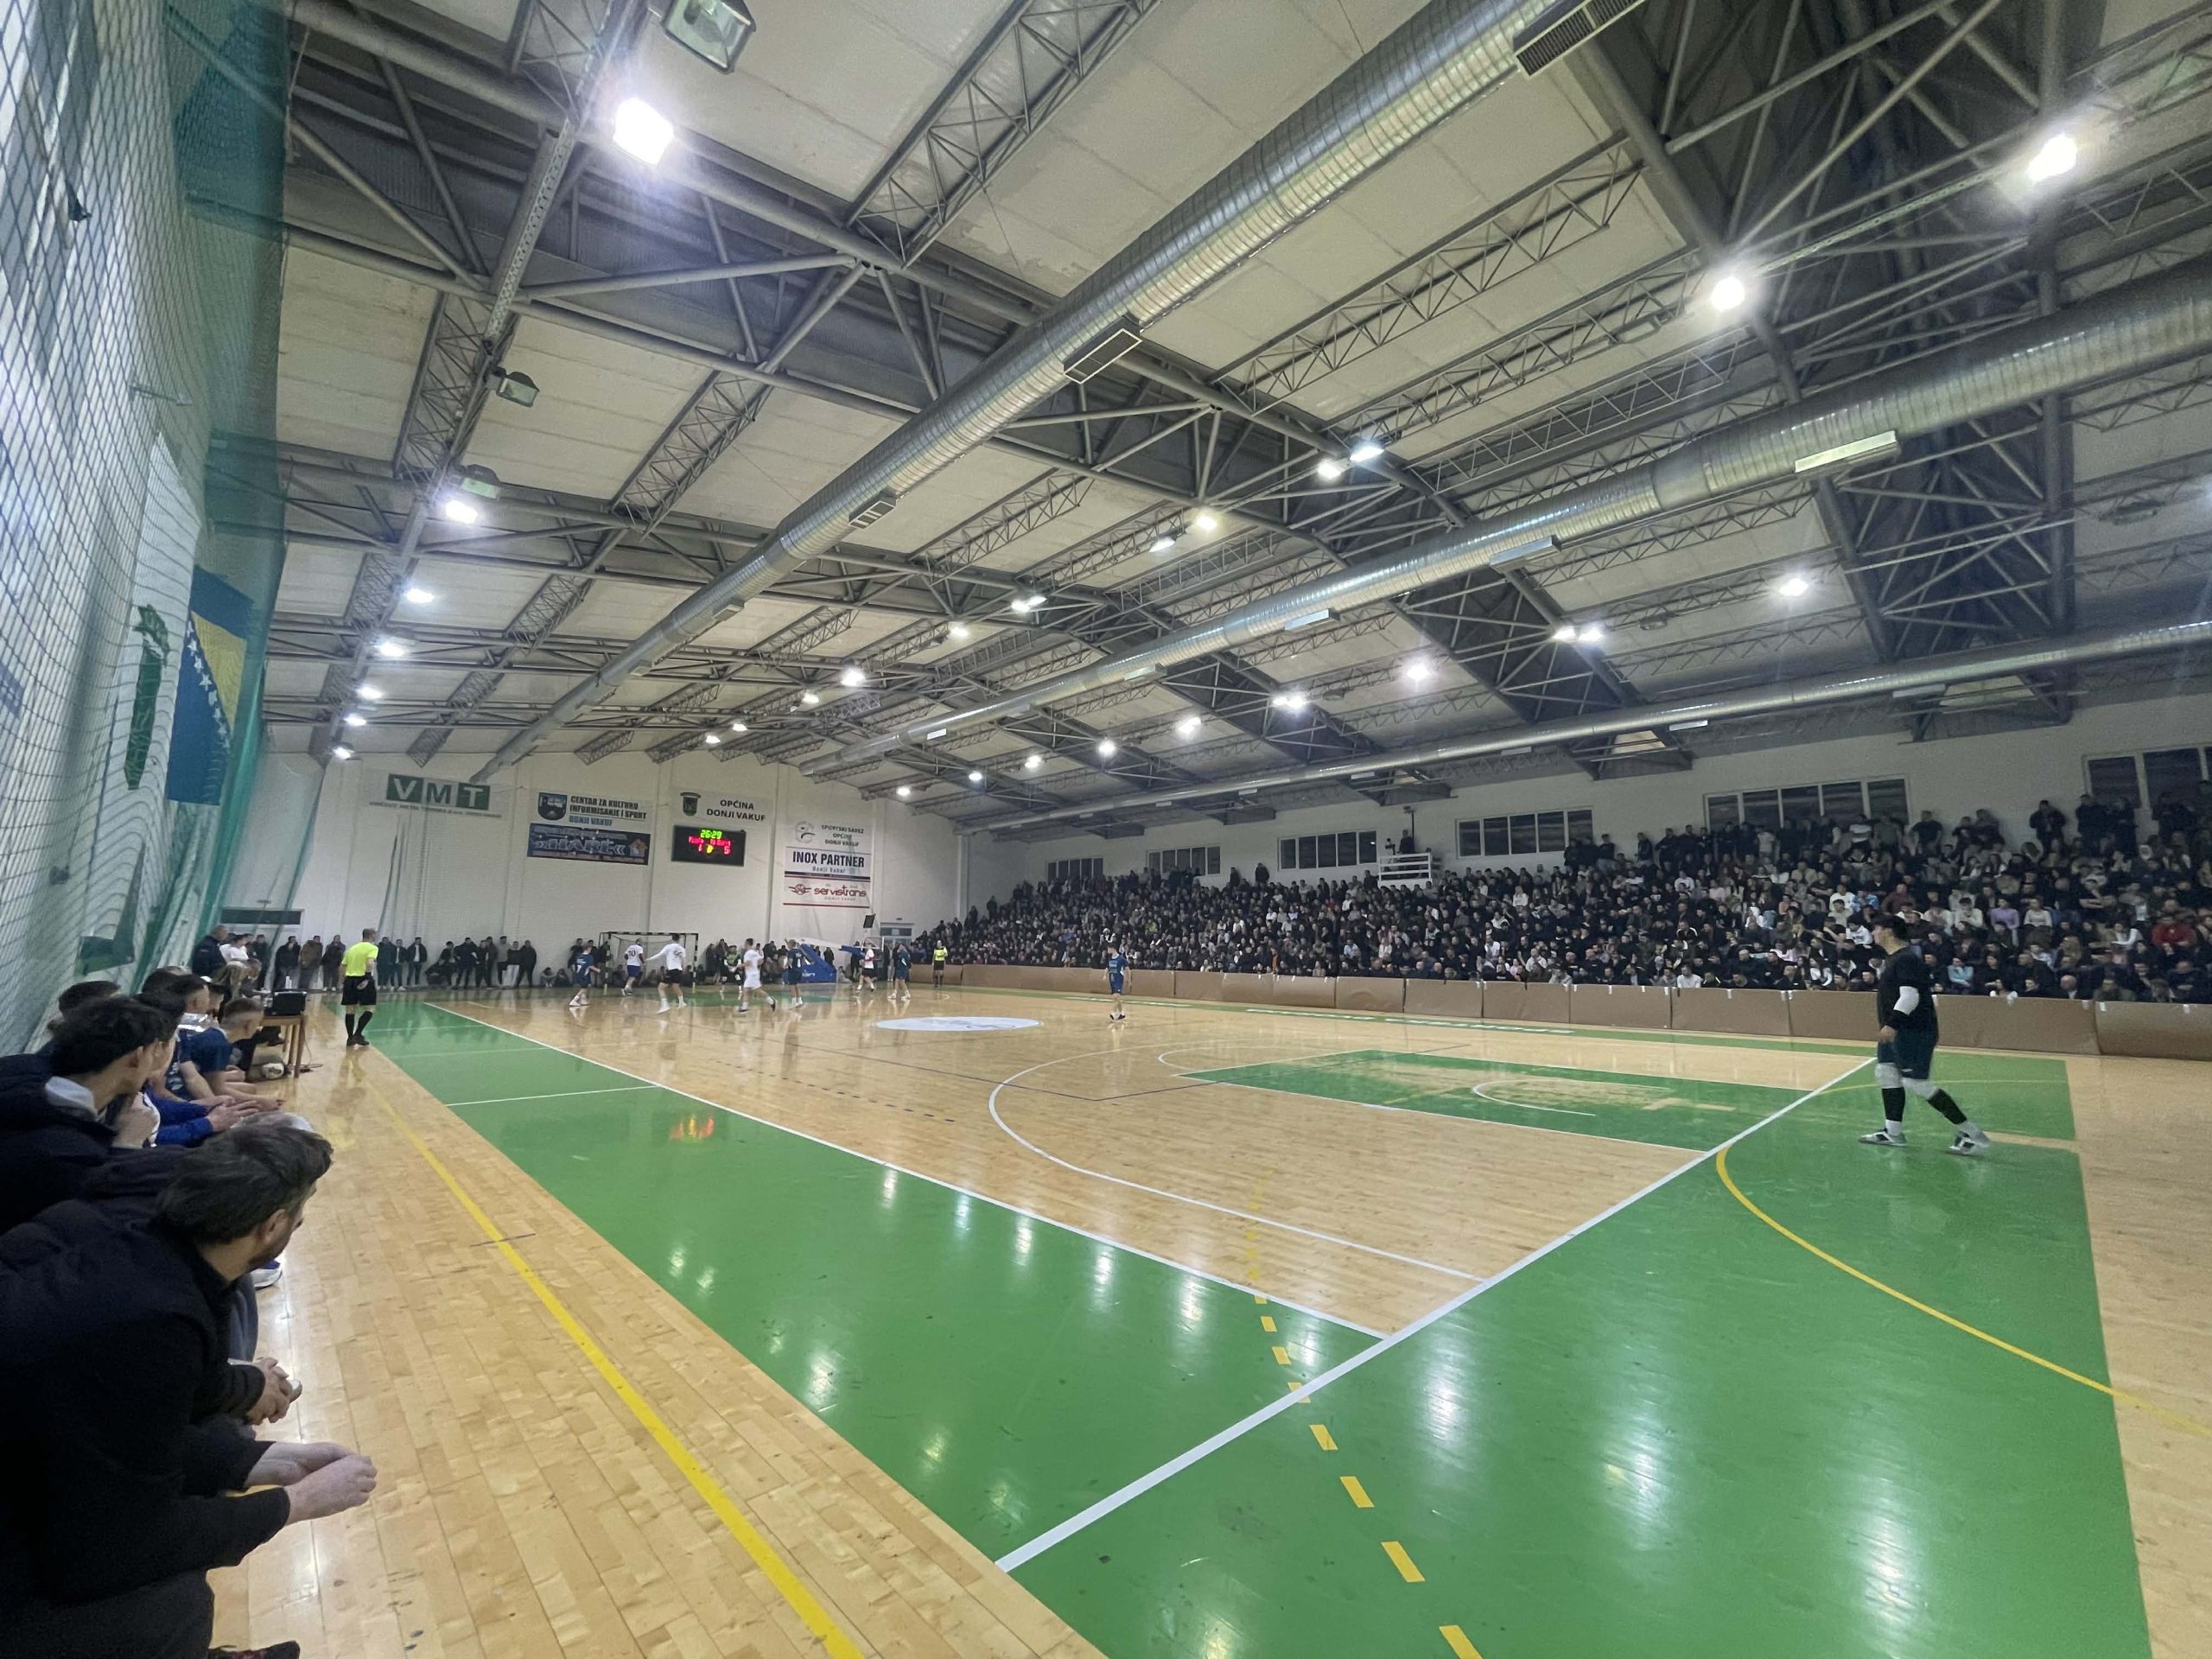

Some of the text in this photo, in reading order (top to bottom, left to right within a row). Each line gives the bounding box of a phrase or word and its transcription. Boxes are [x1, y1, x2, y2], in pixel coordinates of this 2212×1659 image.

[393, 778, 484, 808] VMT
[570, 796, 598, 806] CENTAR
[599, 798, 607, 807] ZA
[720, 798, 754, 810] OPĆINA
[569, 804, 620, 817] INFORMISANJE
[625, 810, 647, 820] SPORT
[707, 809, 766, 822] DONJI VAKUF
[792, 851, 865, 868] INOX PARTNER
[813, 884, 867, 897] servistrans
